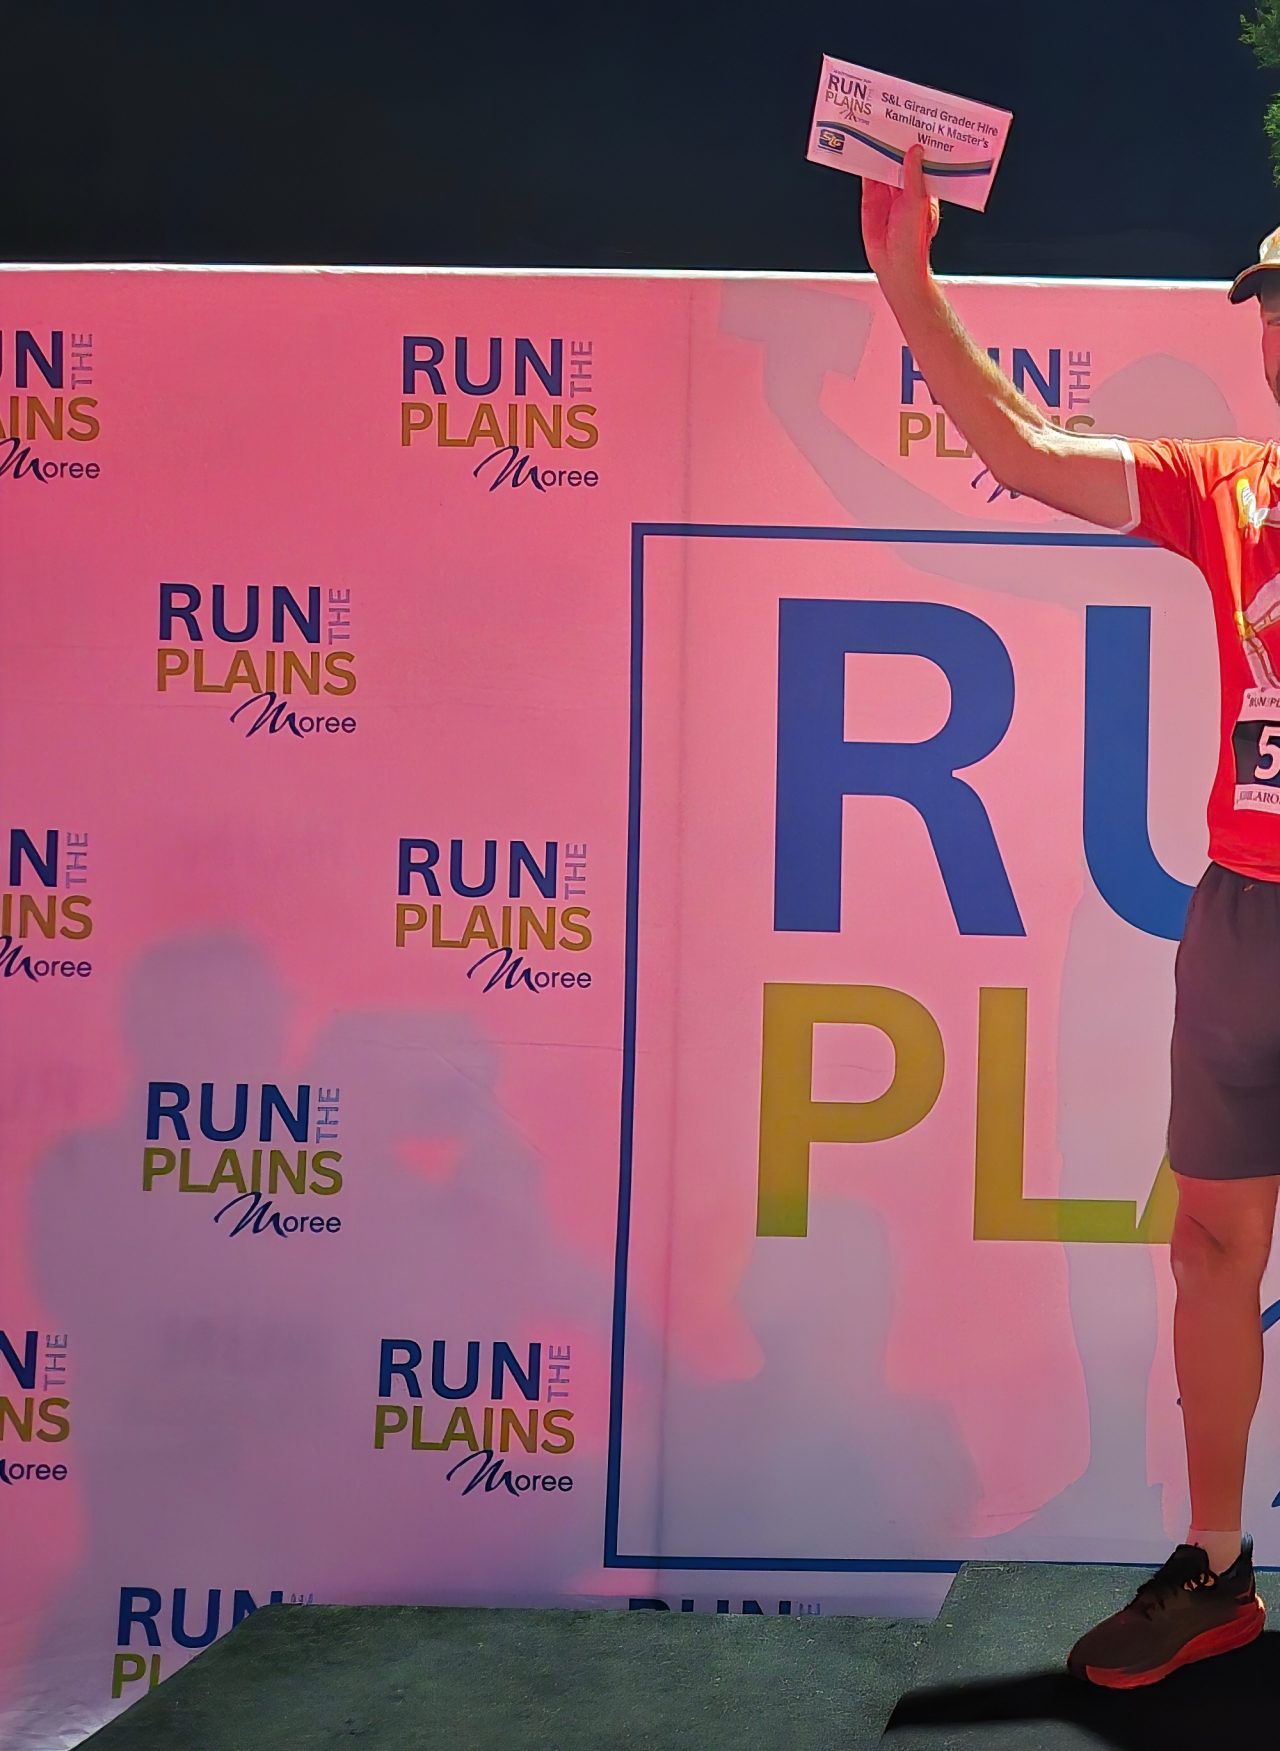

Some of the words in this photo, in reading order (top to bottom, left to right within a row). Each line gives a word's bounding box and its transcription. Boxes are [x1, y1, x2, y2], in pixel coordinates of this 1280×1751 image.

[825, 90, 872, 115] PLAINS
[828, 73, 867, 100] RUN
[881, 92, 902, 108] S&L
[904, 99, 938, 118] Girard
[940, 110, 975, 131] Grader
[978, 122, 999, 137] Hire
[885, 108, 936, 133] Kamilaroi
[937, 123, 945, 135] K
[946, 127, 989, 149] Master's
[917, 132, 954, 153] Winner
[71, 333, 93, 390] THE
[402, 336, 563, 397] RUN
[570, 340, 593, 398] THE
[1069, 351, 1091, 409] THE
[0, 395, 100, 441] INS
[401, 402, 599, 449] PLAINS
[0, 437, 100, 484] Moree
[473, 446, 599, 492] Moree
[158, 582, 321, 644] RUN
[328, 588, 351, 645] THE
[156, 648, 357, 696] PLAINS
[229, 692, 357, 738] Moree
[66, 832, 88, 889] THE
[398, 838, 558, 899] RUN
[563, 842, 588, 900] THE
[2, 894, 93, 940] INS
[395, 903, 593, 951] PLAINS
[466, 946, 592, 994] Moree
[145, 1081, 311, 1143] RUN
[315, 1086, 340, 1144] THE
[142, 1146, 344, 1195] PLAINS
[213, 1191, 341, 1238] Moree
[43, 1334, 68, 1391] THE
[378, 1338, 542, 1402] RUN
[547, 1343, 572, 1403] THE
[373, 1404, 576, 1455] PLAINS
[0, 1459, 68, 1485] oree
[446, 1449, 574, 1497] Moree
